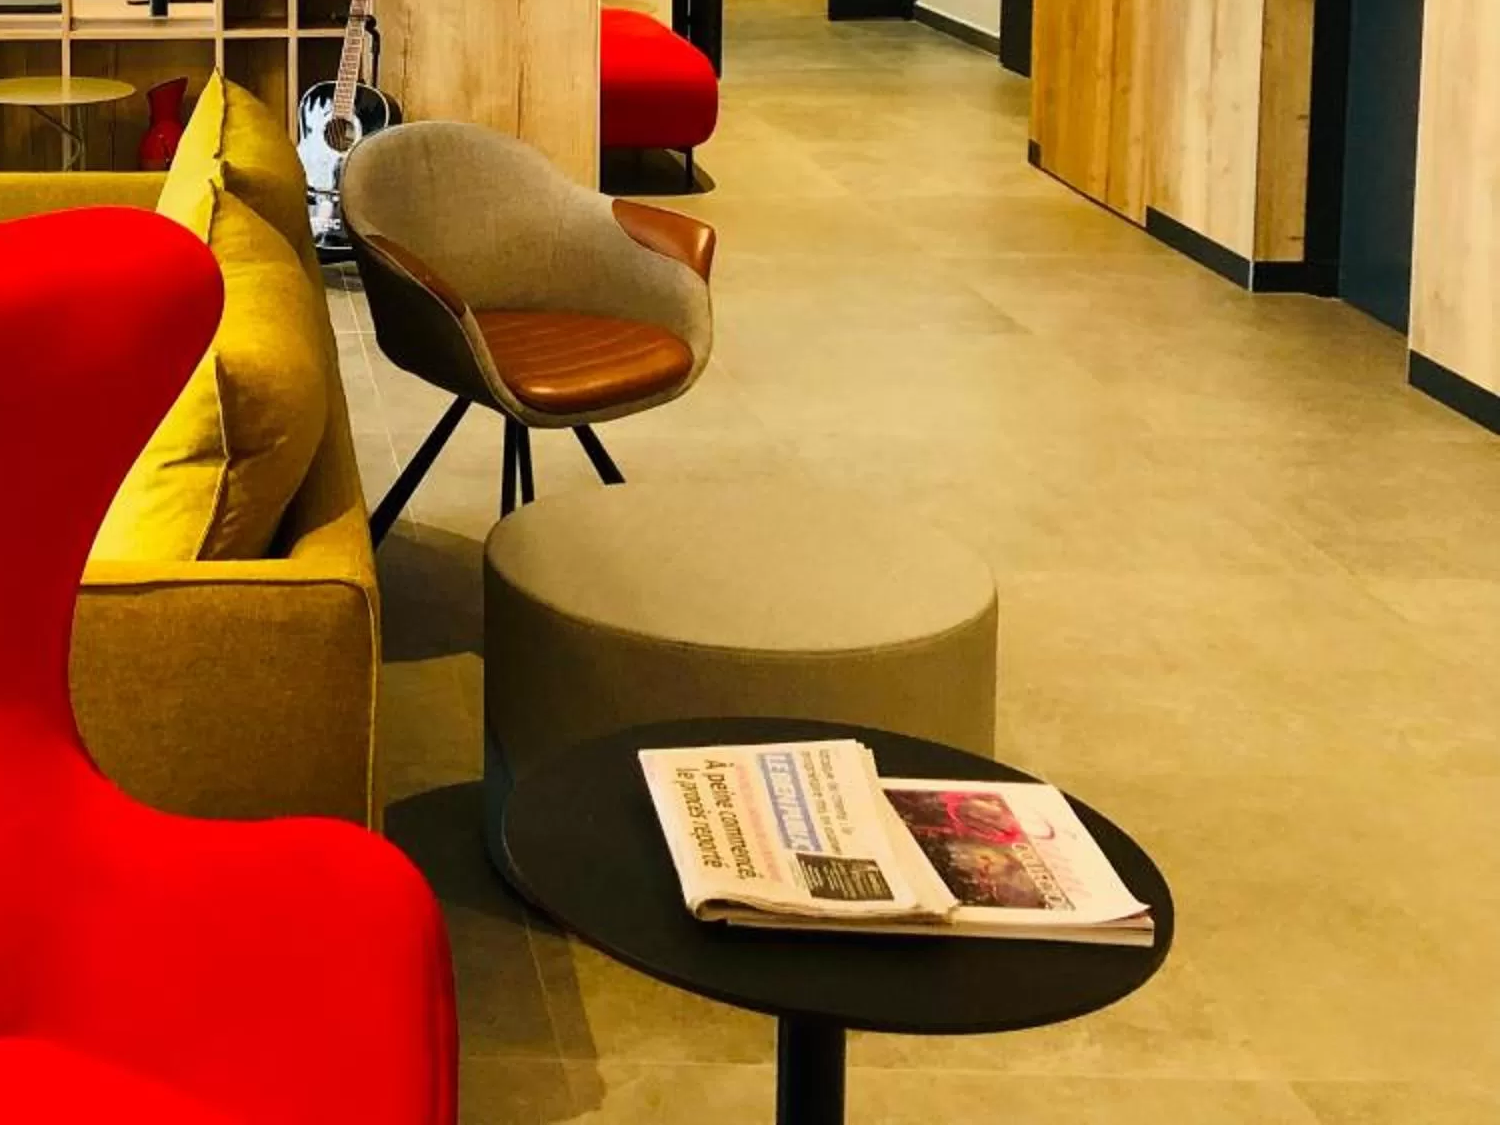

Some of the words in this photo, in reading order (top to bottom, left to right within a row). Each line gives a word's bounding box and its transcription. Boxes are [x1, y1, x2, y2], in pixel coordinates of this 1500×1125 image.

[675, 768, 700, 780] le
[702, 773, 736, 808] peine
[673, 780, 712, 820] procès
[690, 820, 730, 868] reporté
